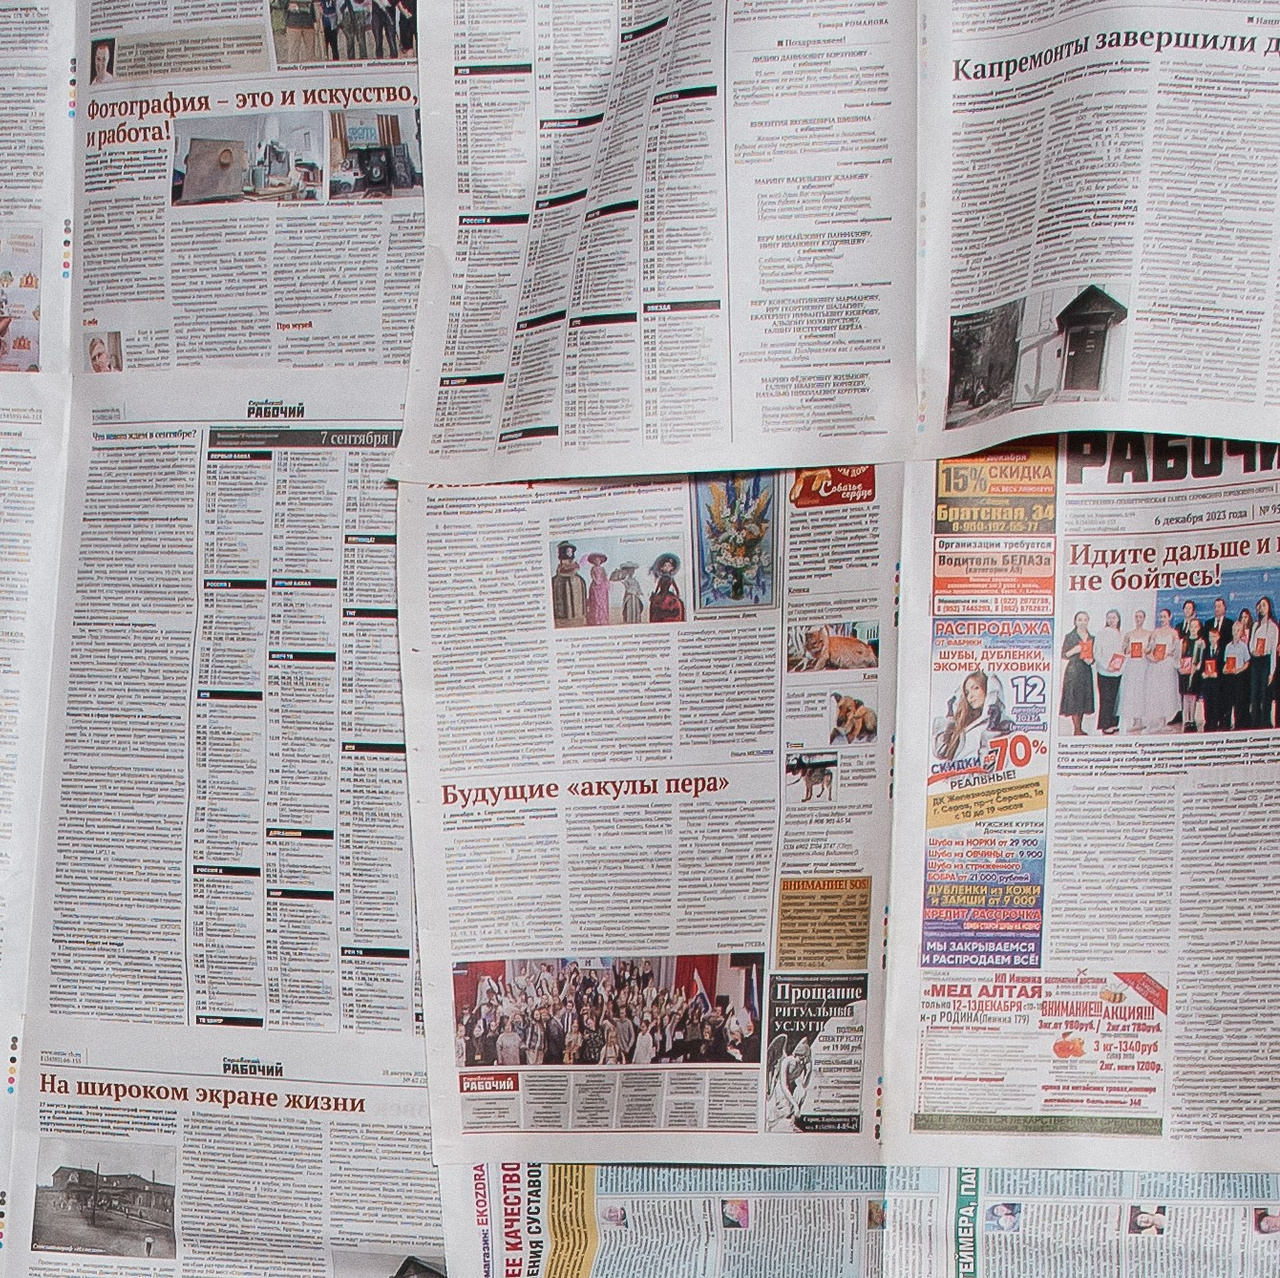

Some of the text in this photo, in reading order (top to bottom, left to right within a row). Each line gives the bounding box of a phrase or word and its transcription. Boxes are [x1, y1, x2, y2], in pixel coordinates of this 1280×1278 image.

[952, 30, 1257, 81] Капремонты завершили
[87, 85, 419, 120] Фотография это и искусство,
[87, 120, 171, 150] и работа!
[247, 403, 304, 418] РАБОЧИЙ
[942, 466, 1052, 495] 15% СКИДКА
[1154, 509, 1247, 526] 6 декабря 2023 года
[939, 540, 1052, 550] Организации требуется
[1068, 538, 1272, 567] Идите дальше и
[938, 554, 1051, 567] Водитель БЕЛАЗа
[1068, 564, 1221, 591] не бойтесь!
[935, 623, 1051, 636] РАСПРОДАЖА
[939, 650, 1045, 662] ШУБЫ, ДУБЛЕНКИ,
[1011, 676, 1045, 704] 12
[931, 735, 1048, 775] СКИДКИ 70%
[440, 772, 730, 806] Будущие «акулы пера»
[950, 771, 1016, 791] РЕАЛЬНЫЕ!
[922, 954, 1039, 966] И РАСПРОДАЕМ ВСЁ!
[926, 942, 1035, 953] МЫ ЗАКРЫВАЕМСЯ
[40, 1074, 366, 1113] На широком экране жизни
[501, 1163, 522, 1254] КАЧЕСТВО
